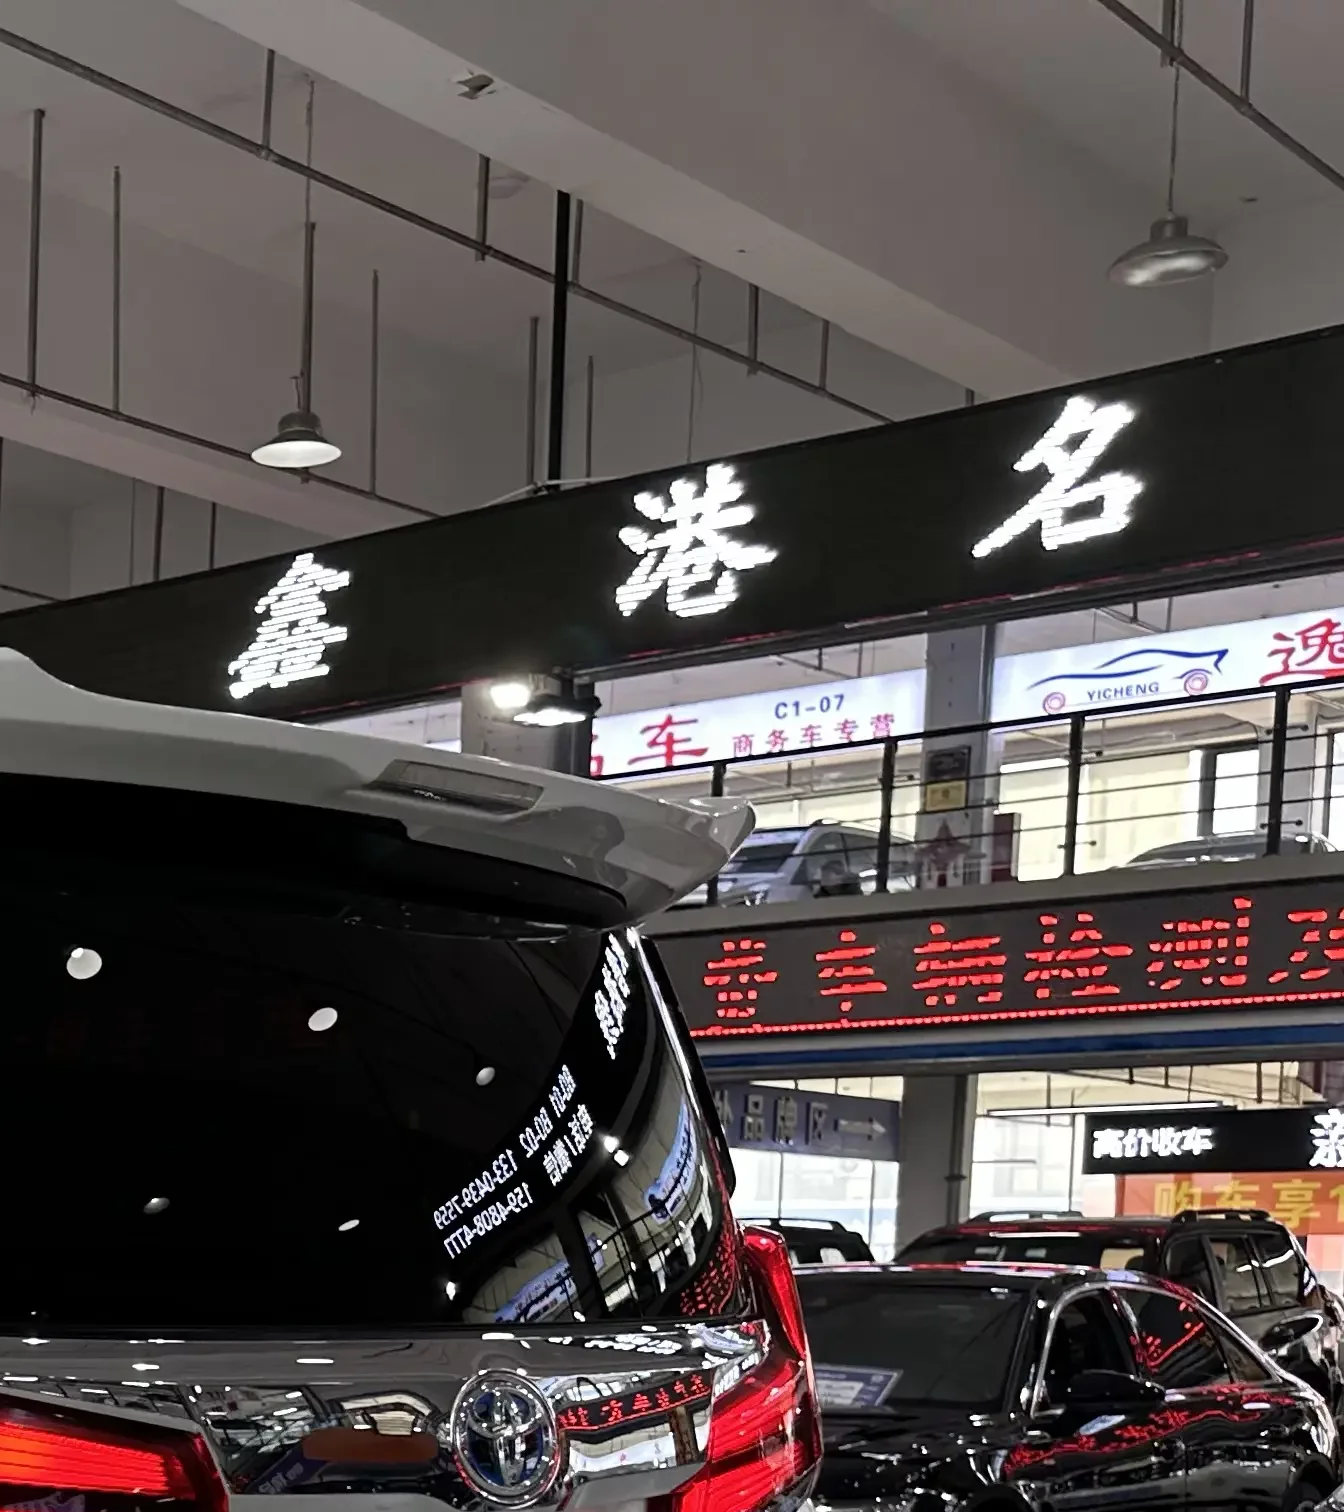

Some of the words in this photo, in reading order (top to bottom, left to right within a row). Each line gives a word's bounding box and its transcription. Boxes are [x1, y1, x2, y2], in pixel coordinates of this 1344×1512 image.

[774, 694, 845, 720] C1-07
[1087, 681, 1160, 702] YICHENG
[732, 713, 895, 758] 商务车专营
[1092, 1126, 1214, 1159] 高价收车
[1153, 1178, 1344, 1230] 购车享
